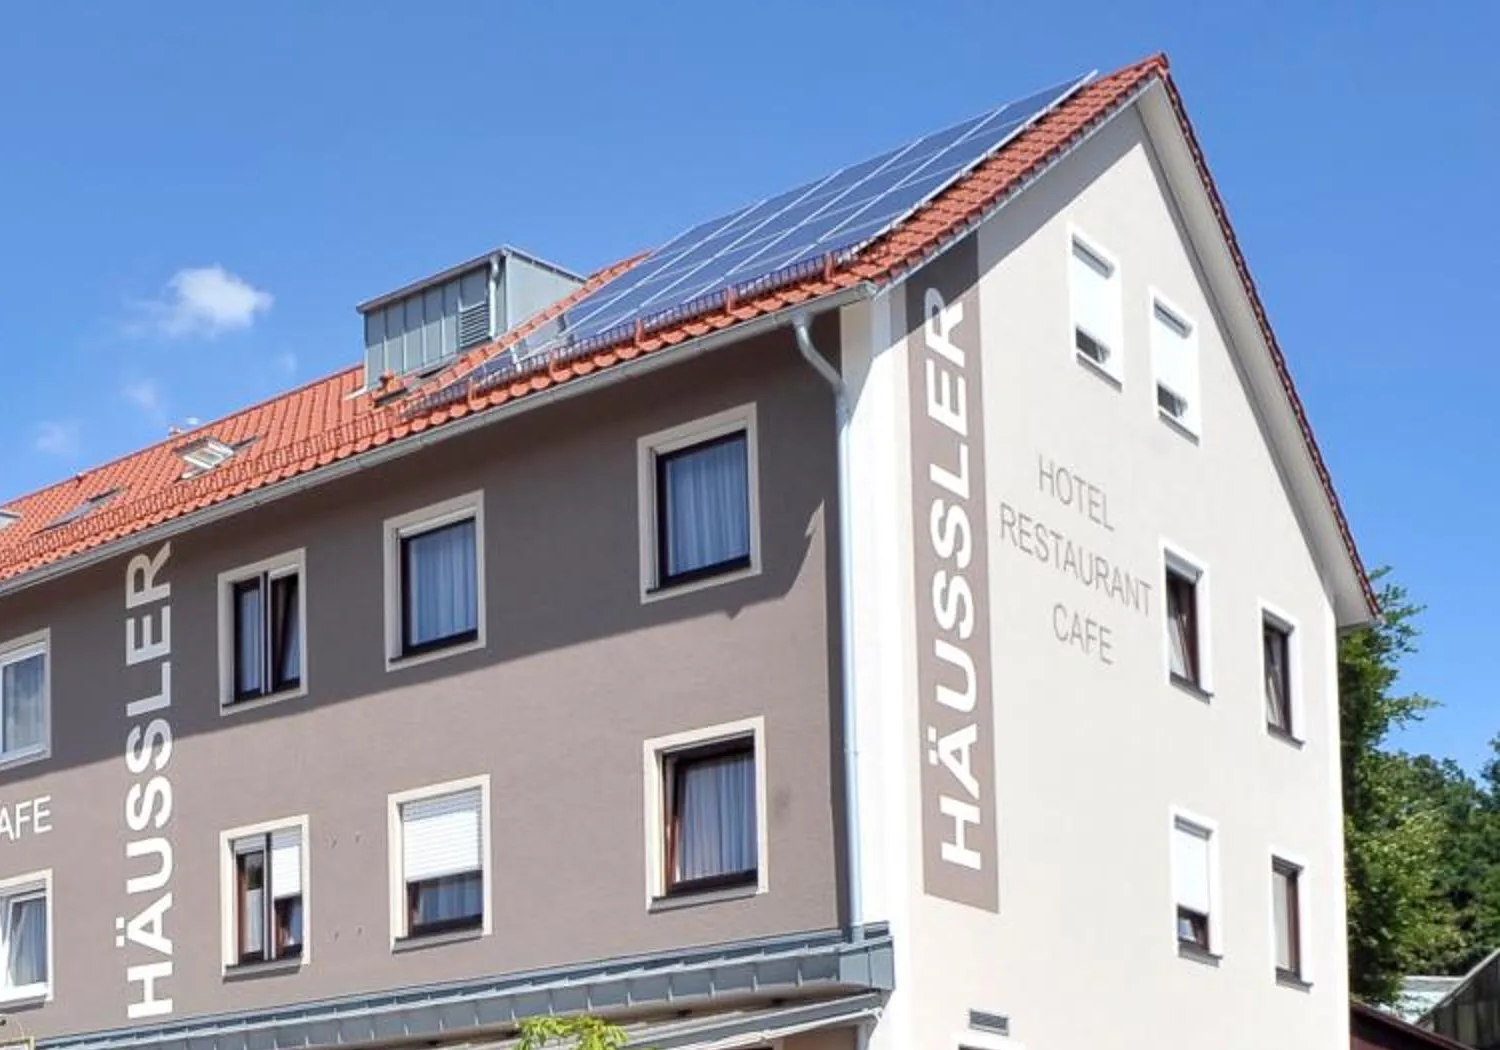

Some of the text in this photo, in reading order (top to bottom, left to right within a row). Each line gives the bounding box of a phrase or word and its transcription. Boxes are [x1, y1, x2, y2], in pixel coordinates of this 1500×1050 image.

[1038, 453, 1115, 531] HOTEL
[923, 287, 982, 871] HÄUSSLER
[1000, 502, 1152, 616] RESTAURANT
[1053, 603, 1114, 665] CAFE
[115, 540, 173, 1019] HÄUSSLER
